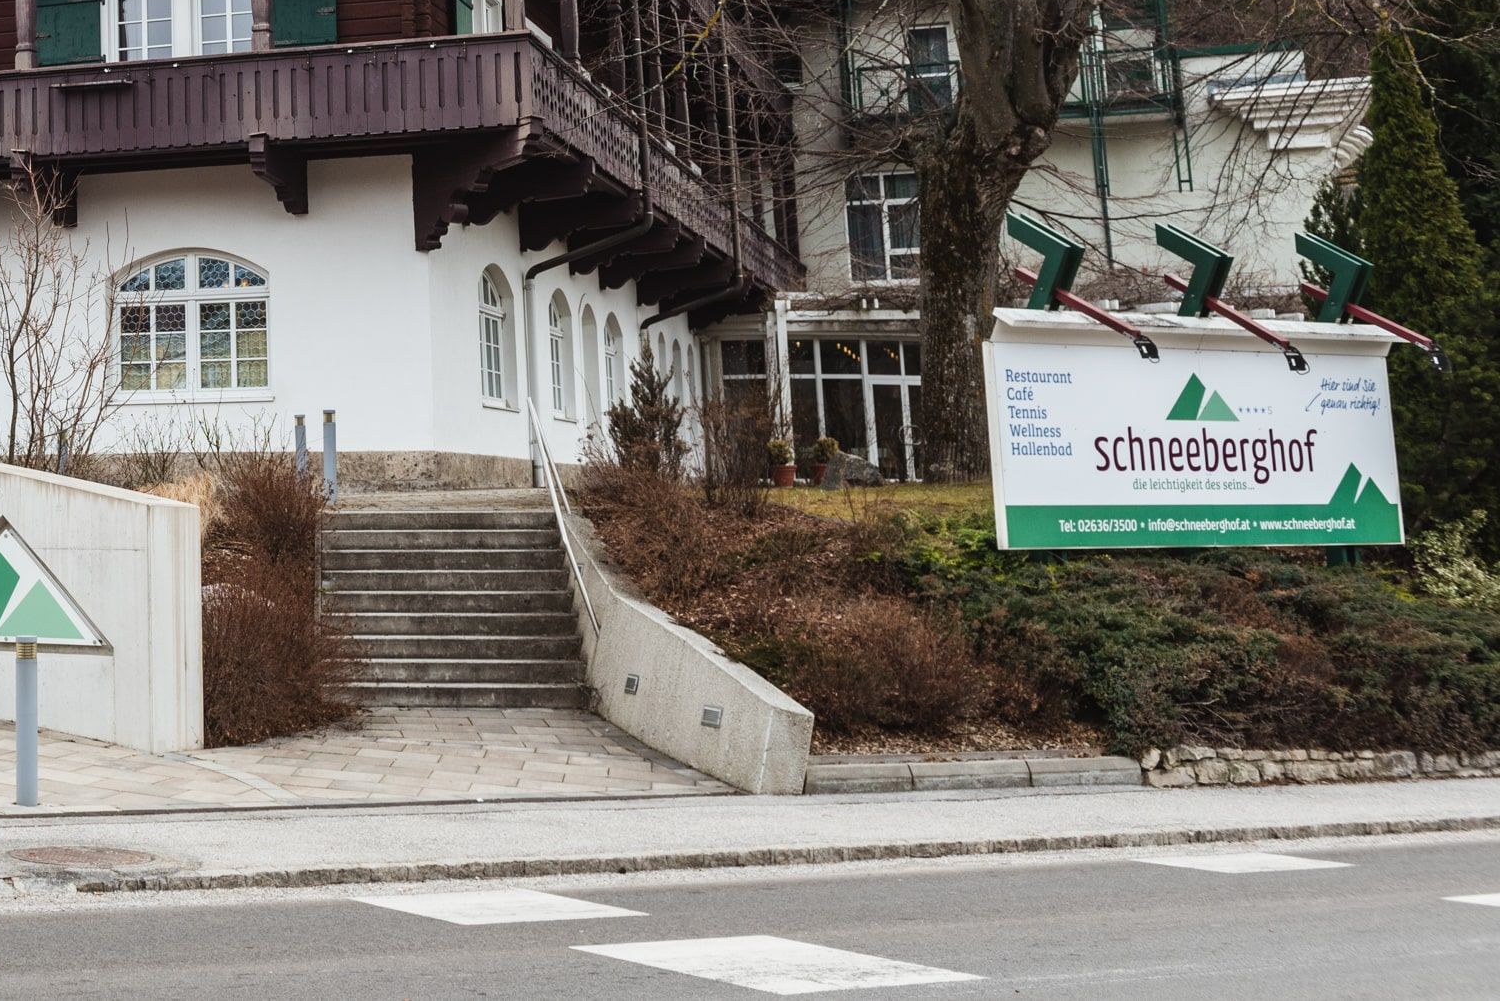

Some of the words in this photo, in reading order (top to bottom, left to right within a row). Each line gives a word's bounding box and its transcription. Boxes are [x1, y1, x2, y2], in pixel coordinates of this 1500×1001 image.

[1005, 369, 1072, 384] Restaurant
[1320, 378, 1340, 391] Hier
[1341, 377, 1361, 392] sind
[1362, 379, 1376, 392] Sie
[1007, 386, 1034, 401] Café
[1007, 405, 1048, 419] Tennis
[1320, 399, 1348, 415] genau
[1350, 395, 1381, 416] richtig!
[1009, 423, 1062, 438] Wellness
[1011, 442, 1073, 456] Hallenbad
[1094, 426, 1318, 484] schneeberghof
[1132, 478, 1148, 491] die
[1149, 478, 1203, 493] leichtigkeit
[1204, 478, 1221, 491] des
[1058, 519, 1077, 533] Tel:
[1078, 519, 1137, 532] 02636/3500
[1148, 518, 1250, 534] info@schneeberghof.at
[1260, 517, 1356, 533] www.schneeberghof.at
